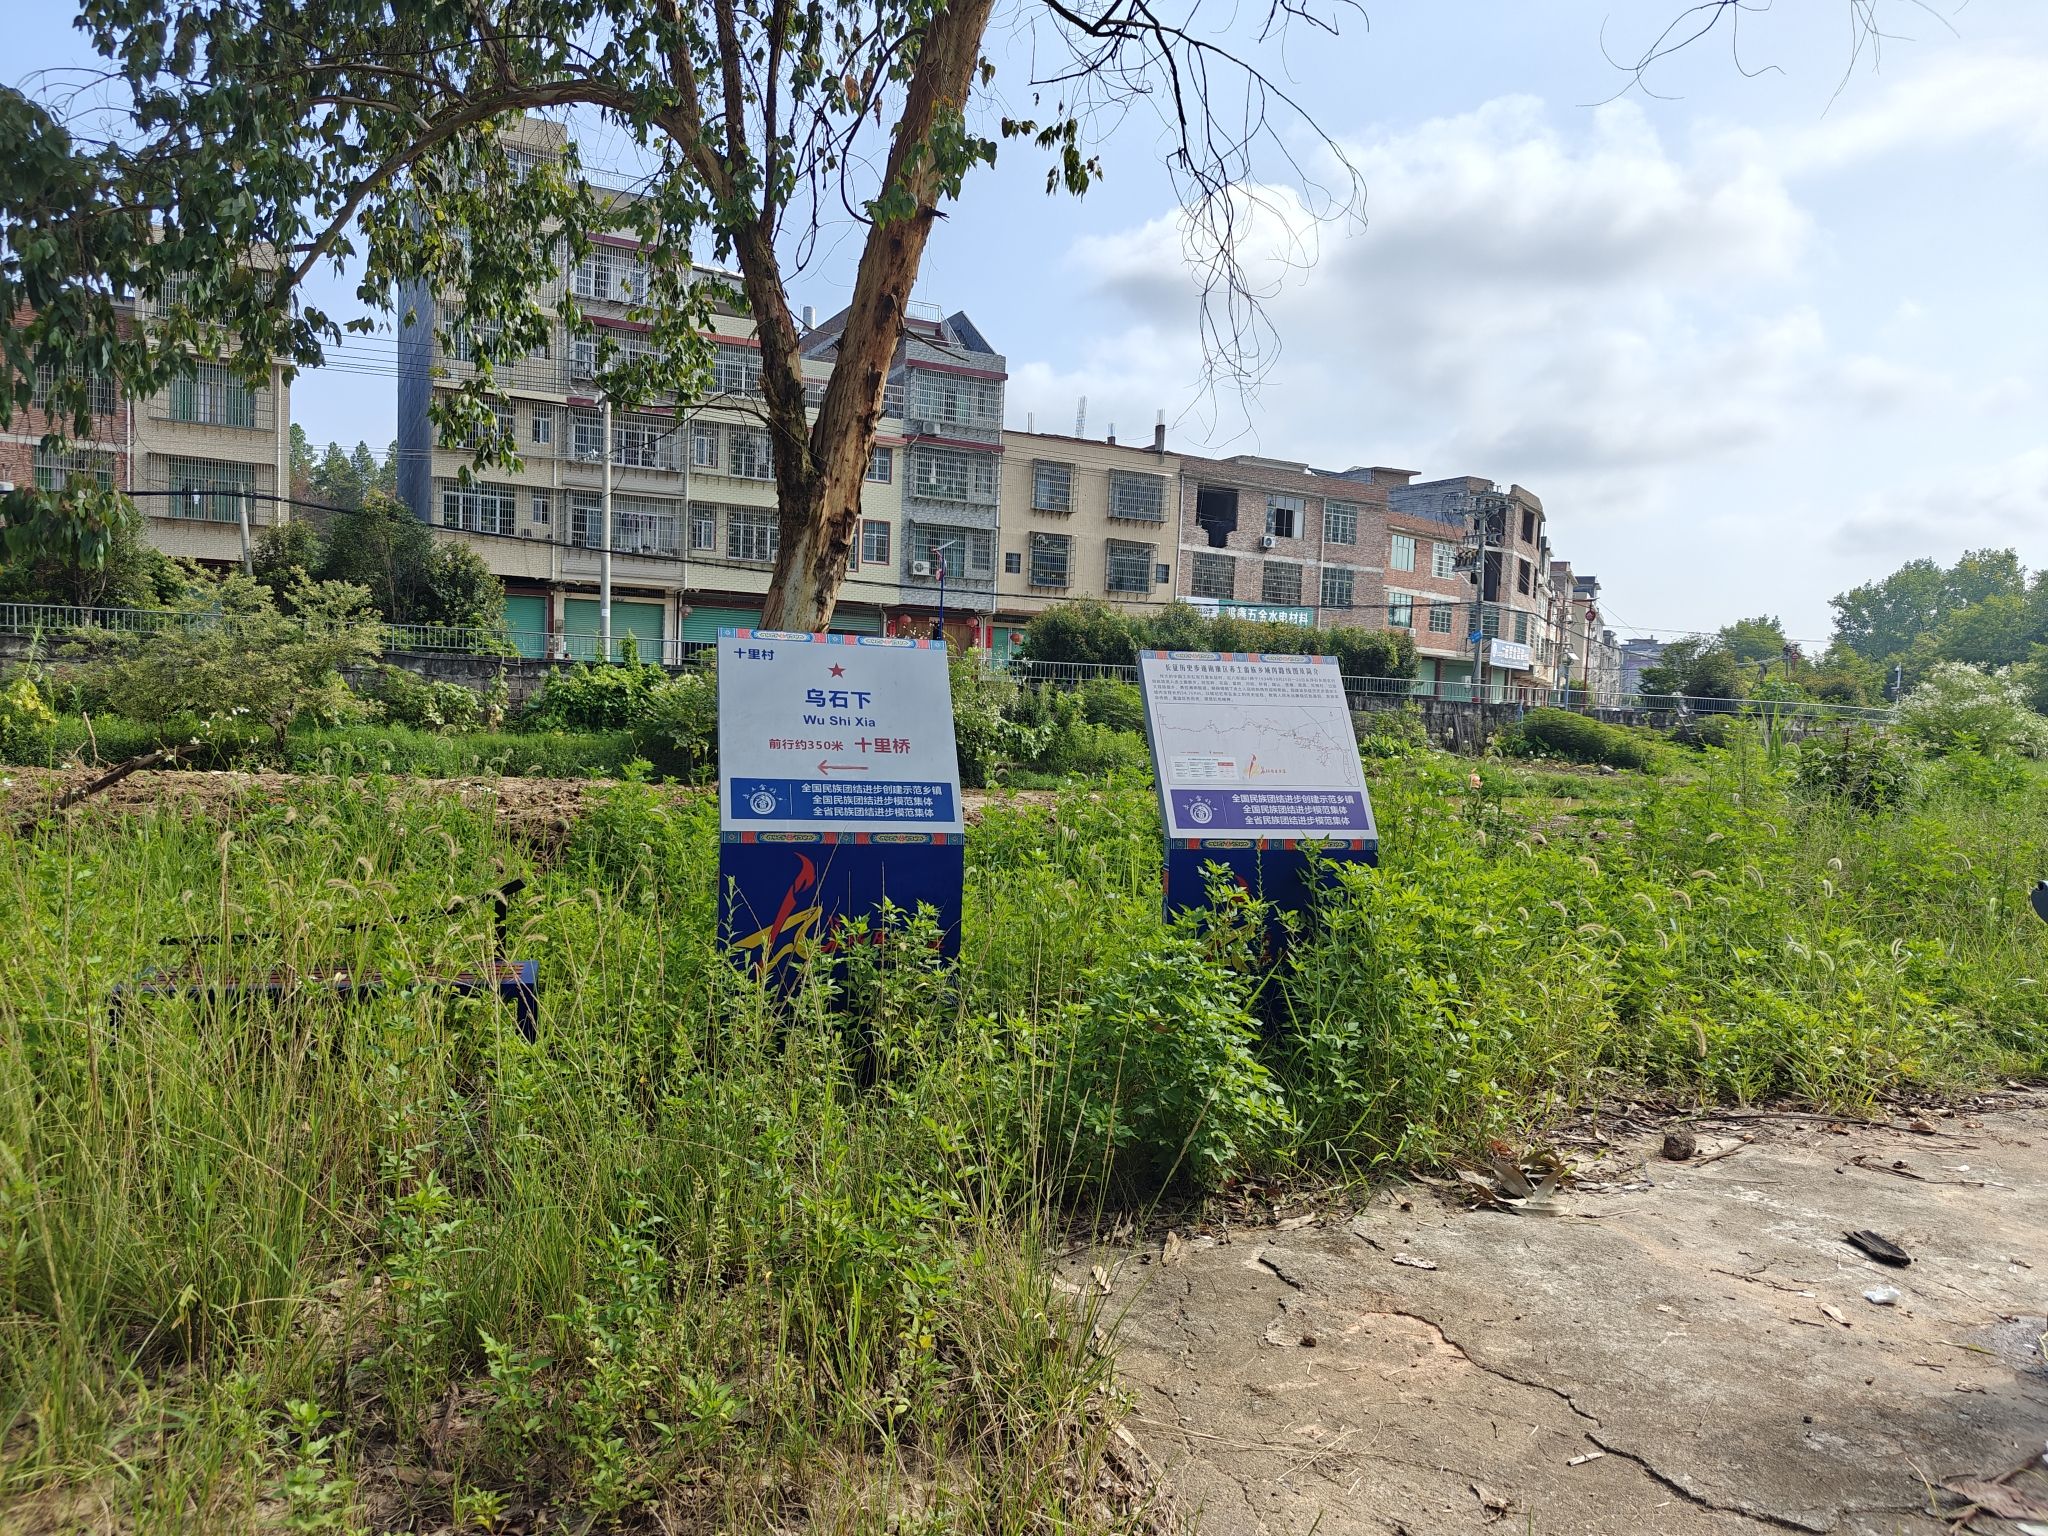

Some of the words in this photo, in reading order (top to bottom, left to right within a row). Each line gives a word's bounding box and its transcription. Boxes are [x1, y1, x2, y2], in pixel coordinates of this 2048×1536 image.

[733, 648, 775, 661] 十里村
[805, 688, 871, 709] 乌石下
[803, 714, 825, 726] Wu
[829, 715, 851, 727] Shi
[855, 716, 876, 728] Xia
[768, 738, 844, 751] 前行约350米
[854, 737, 911, 754] 十里桥
[801, 783, 942, 796] 全国民族团结进步创建示范乡镇
[812, 795, 934, 807] 全国民族团结进步模范集体
[1231, 793, 1355, 805] 全国民族团结进步创建示范乡镇
[812, 806, 935, 818] 全省民族团结进步模范集体
[1243, 805, 1348, 815] 全国民族团结进步模范集体
[1244, 815, 1351, 826] 全省民族团结进步模范集体
